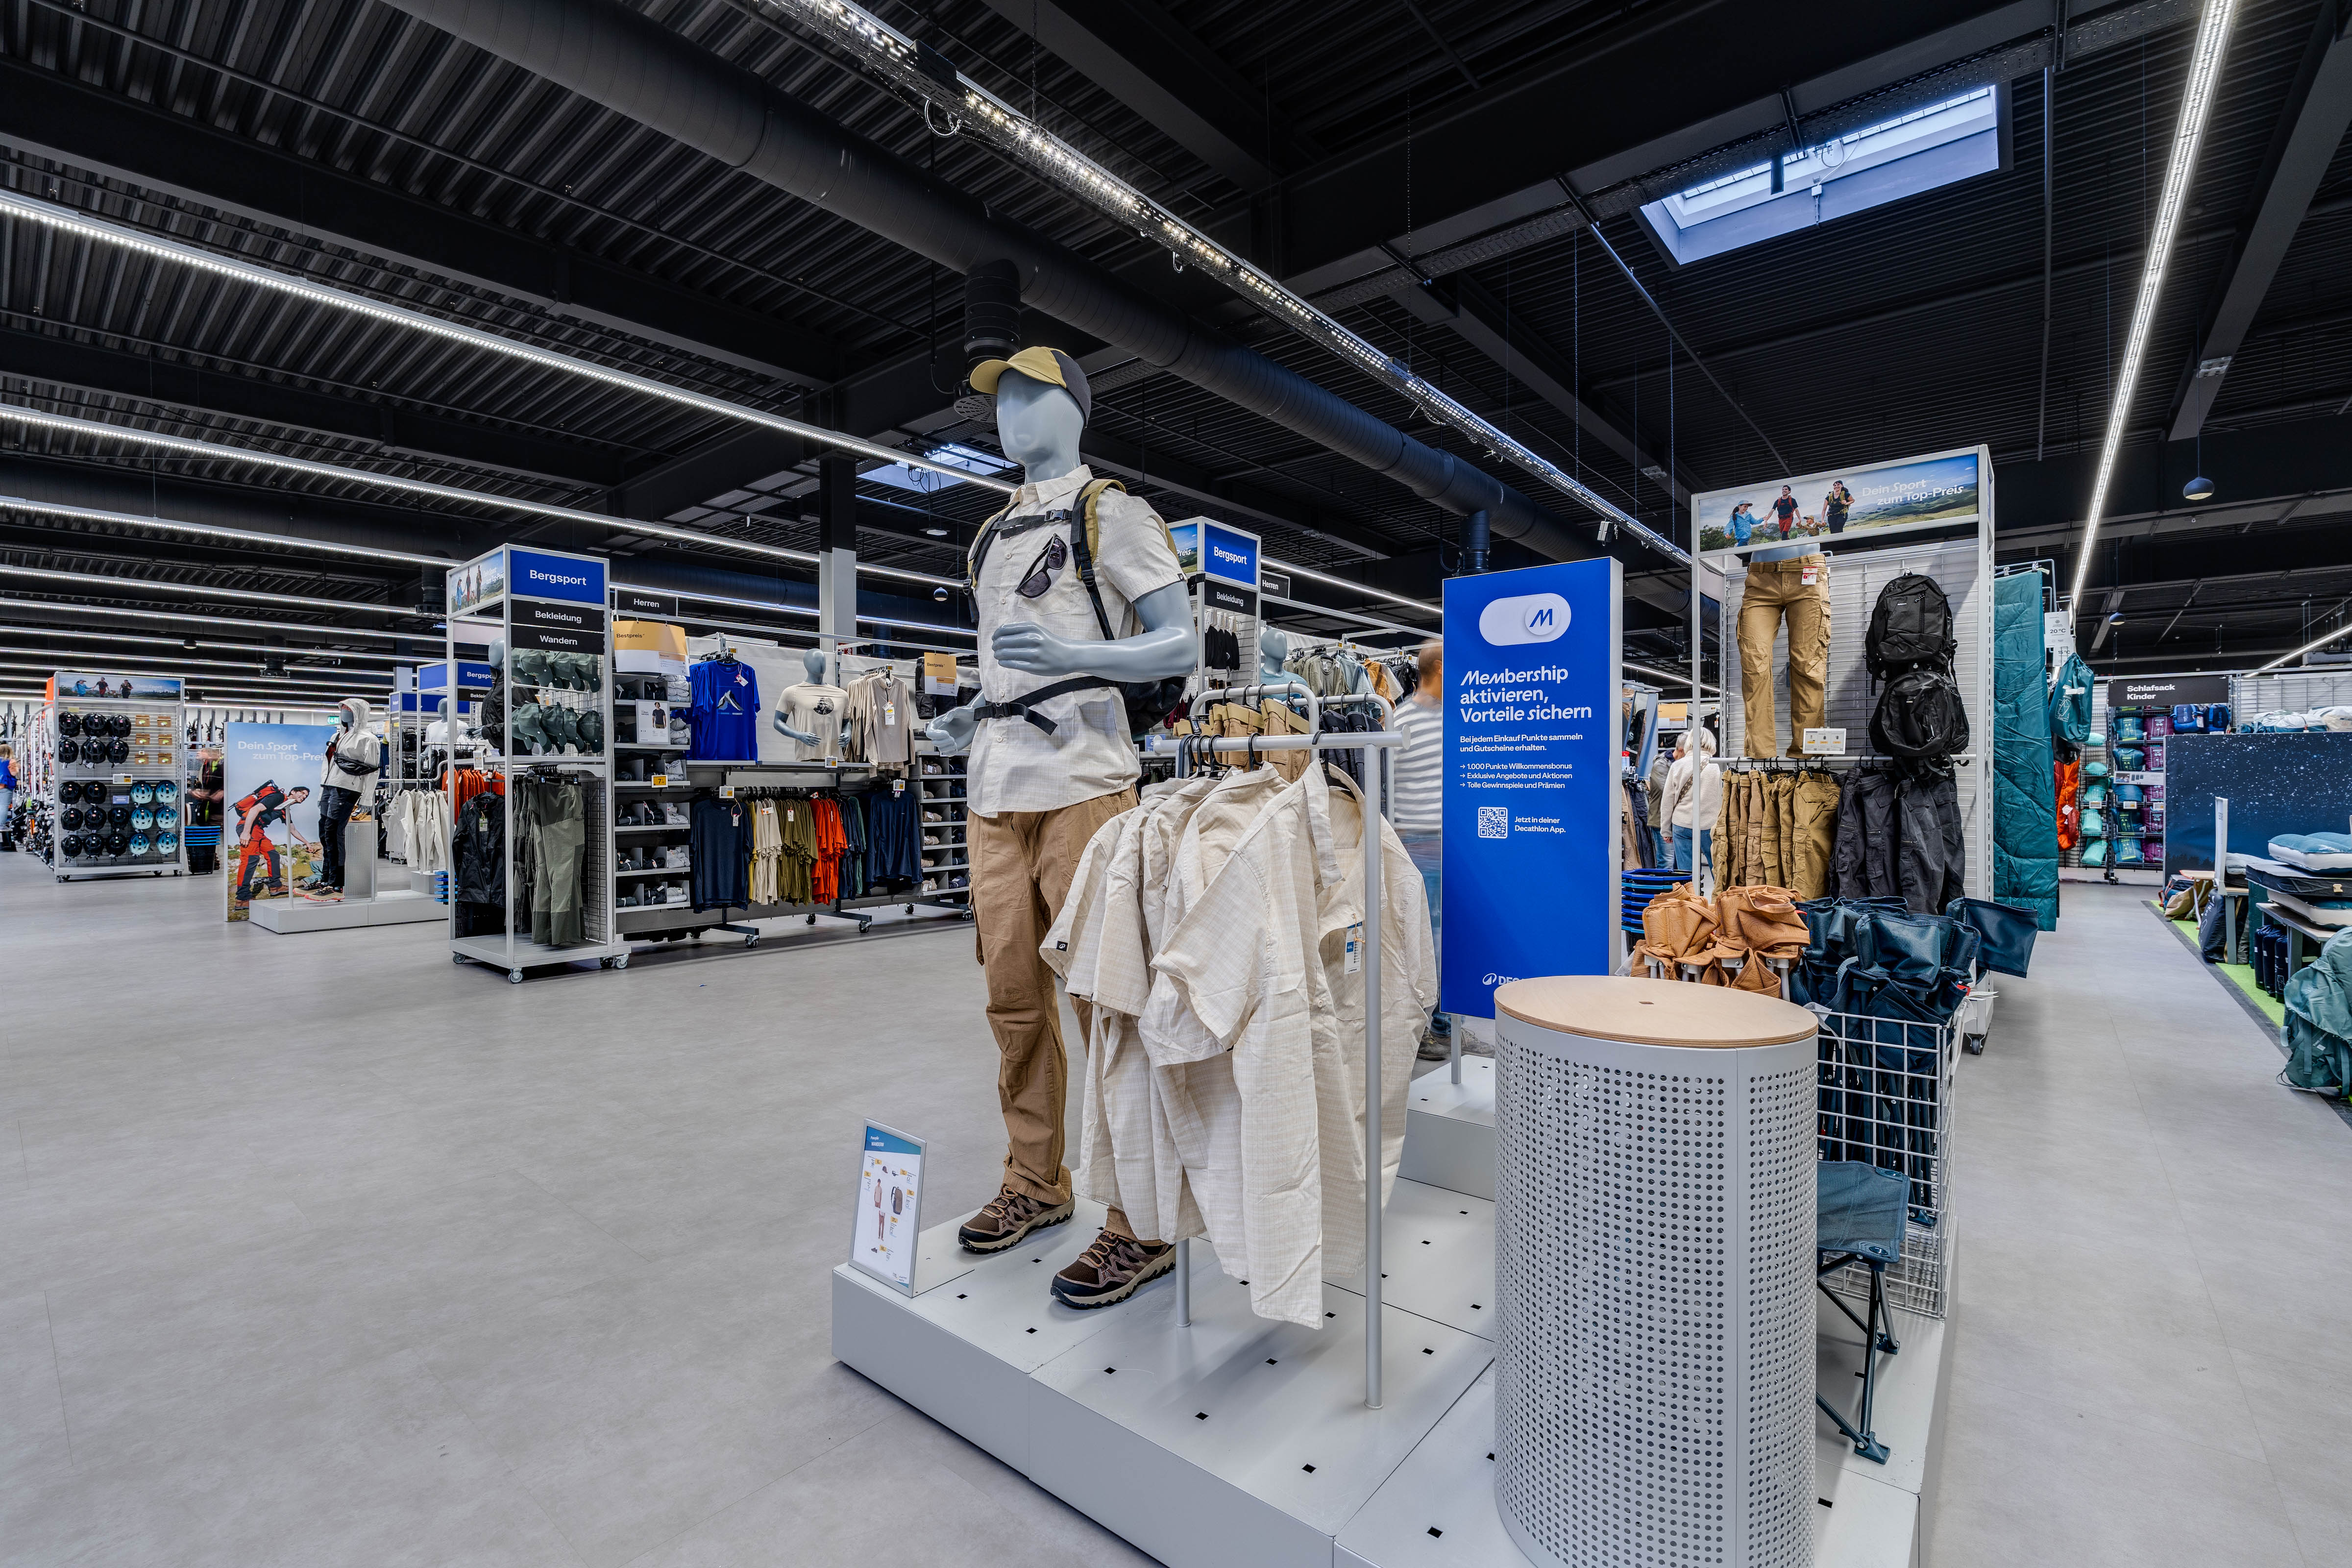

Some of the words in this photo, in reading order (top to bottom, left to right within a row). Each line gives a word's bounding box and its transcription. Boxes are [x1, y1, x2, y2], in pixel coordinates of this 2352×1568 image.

[1862, 485, 1889, 496] Dein
[1891, 479, 1926, 493] Sport
[1877, 495, 1903, 505] zum
[1904, 485, 1964, 501] Top-Preis
[1214, 546, 1247, 564] Bergsport
[530, 569, 587, 586] Bergsport
[1262, 580, 1278, 590] Herren
[634, 598, 660, 608] Herren
[1217, 591, 1244, 606] Bekleidung
[535, 611, 582, 623] Bekleidung
[1529, 609, 1552, 627] M
[539, 635, 578, 645] Wandern
[1460, 665, 1568, 686] Membership
[1460, 687, 1548, 704] aktivieren,
[1460, 706, 1524, 722] Vorteile
[1527, 704, 1592, 720] sichern
[238, 741, 264, 750] Dein
[266, 742, 297, 752] Sport
[1471, 735, 1493, 744] jedem
[278, 752, 326, 762] Top-Prei
